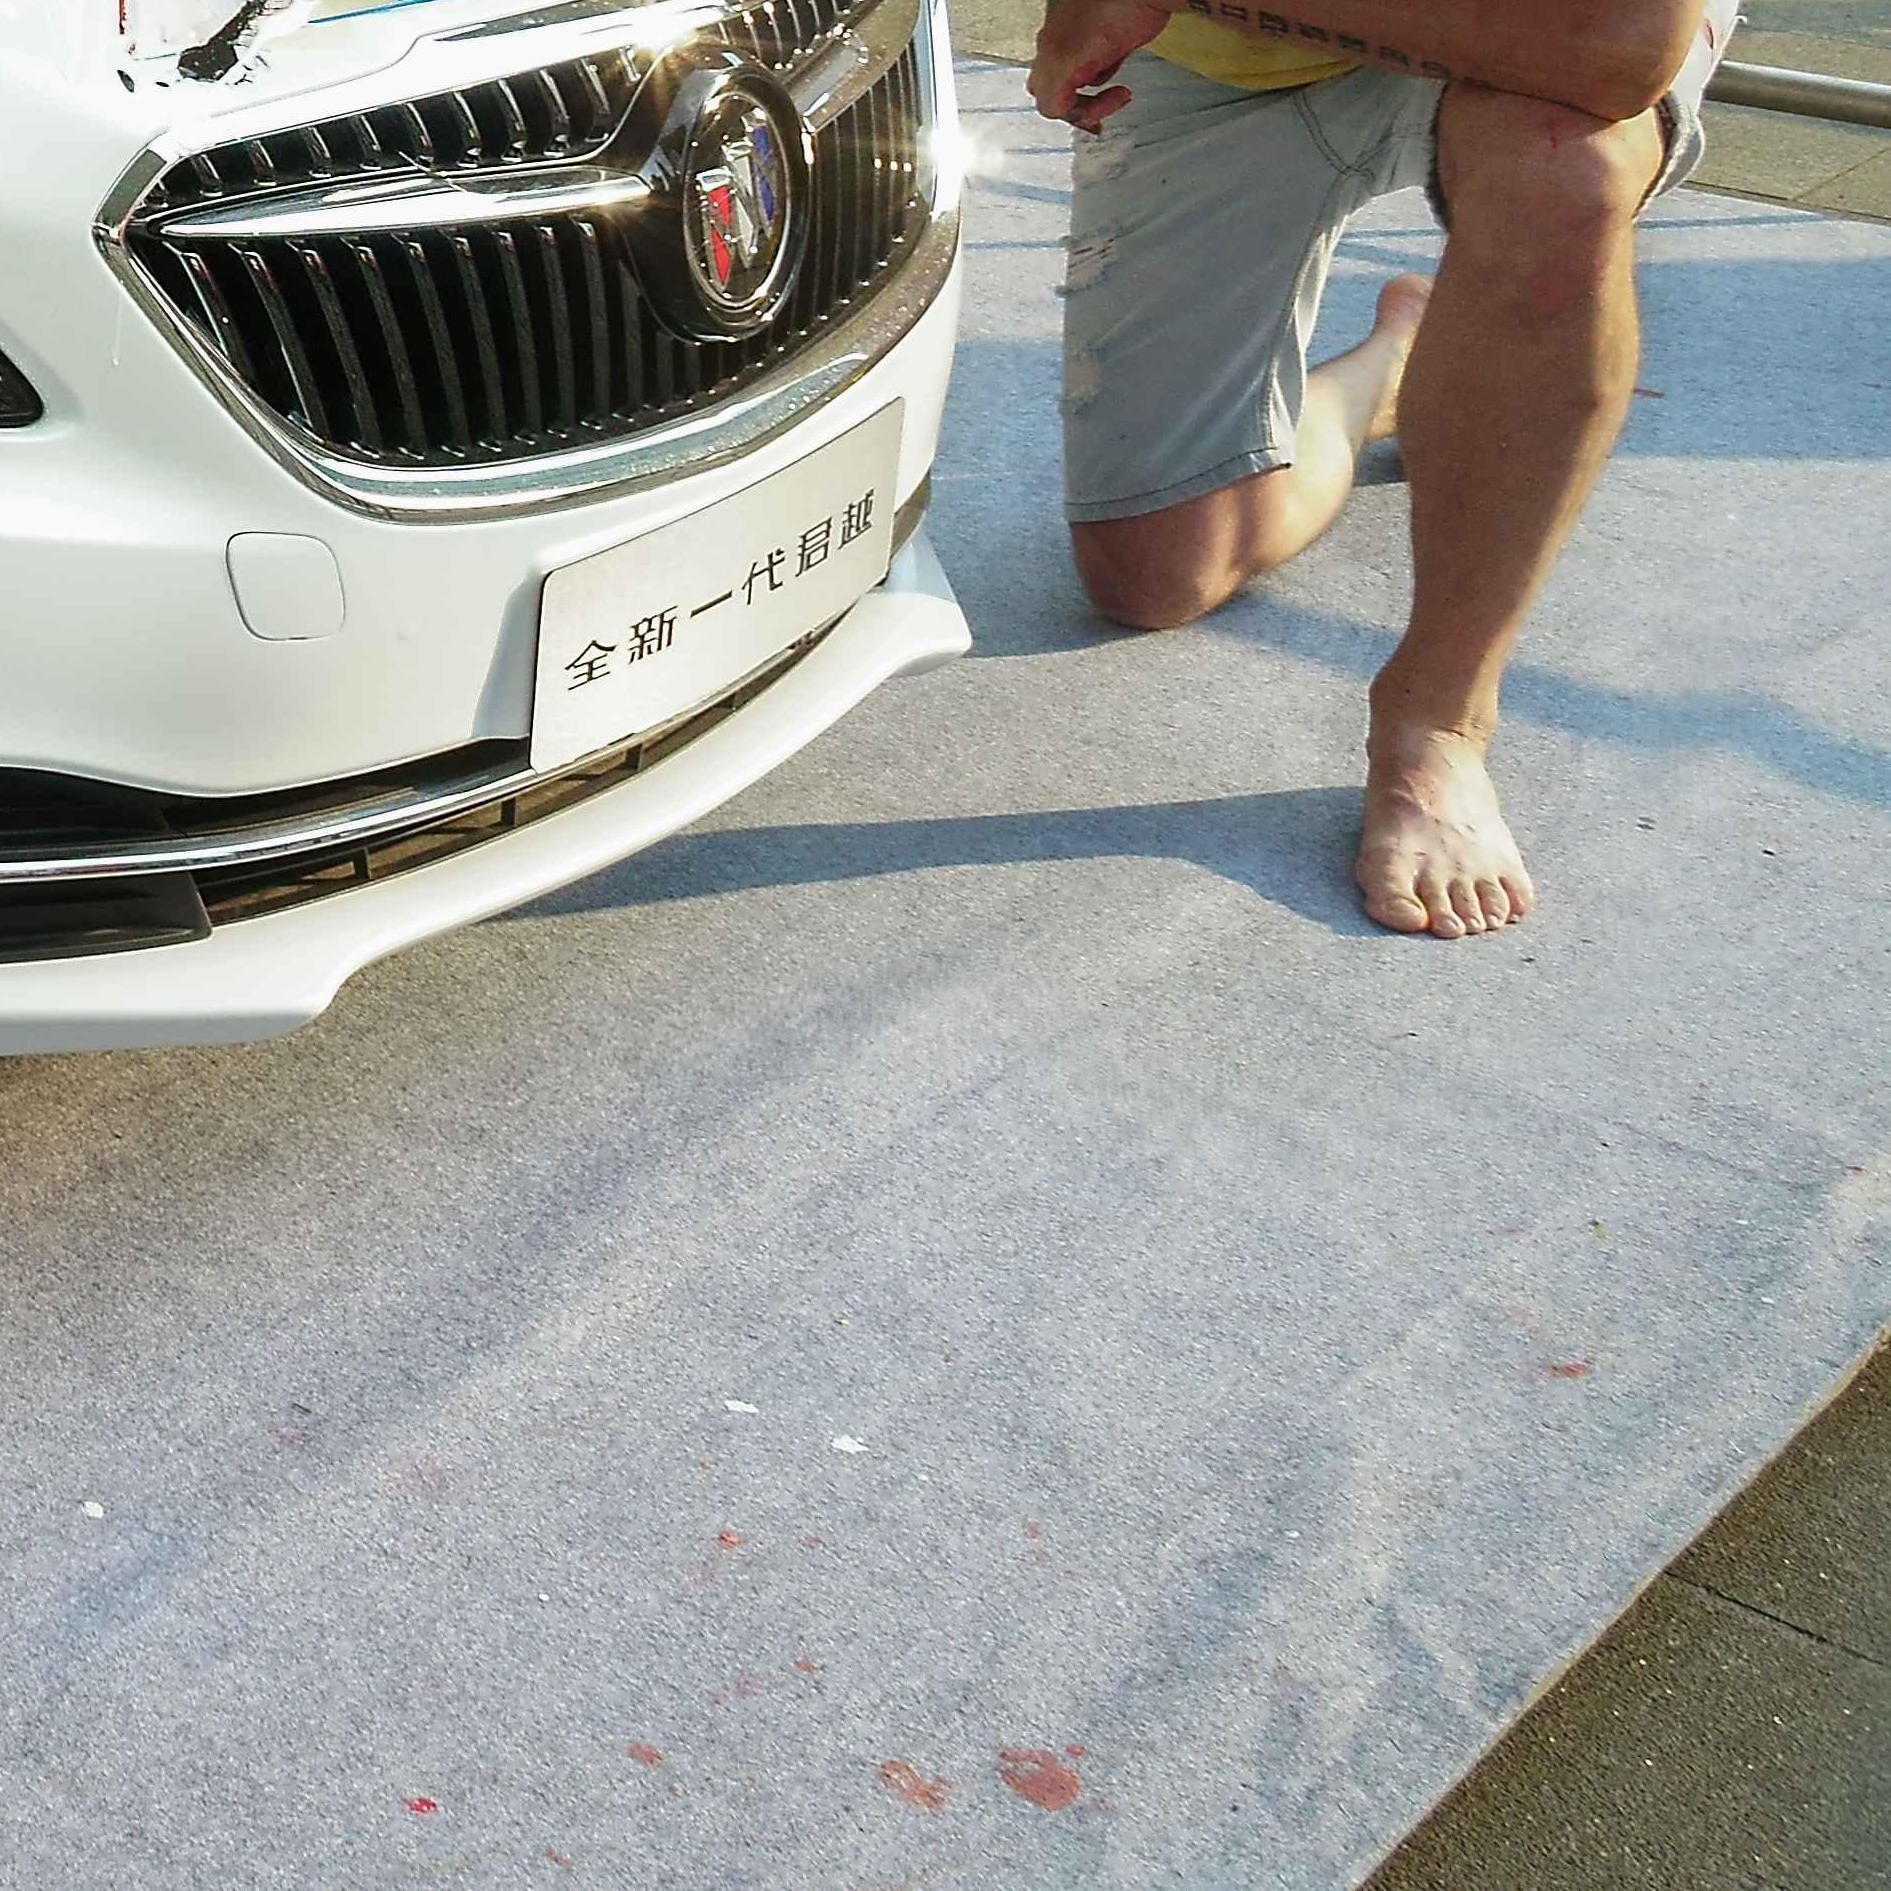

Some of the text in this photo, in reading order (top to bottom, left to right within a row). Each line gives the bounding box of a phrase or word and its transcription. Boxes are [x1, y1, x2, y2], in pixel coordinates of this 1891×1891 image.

[564, 487, 876, 692] 全新一代君越
